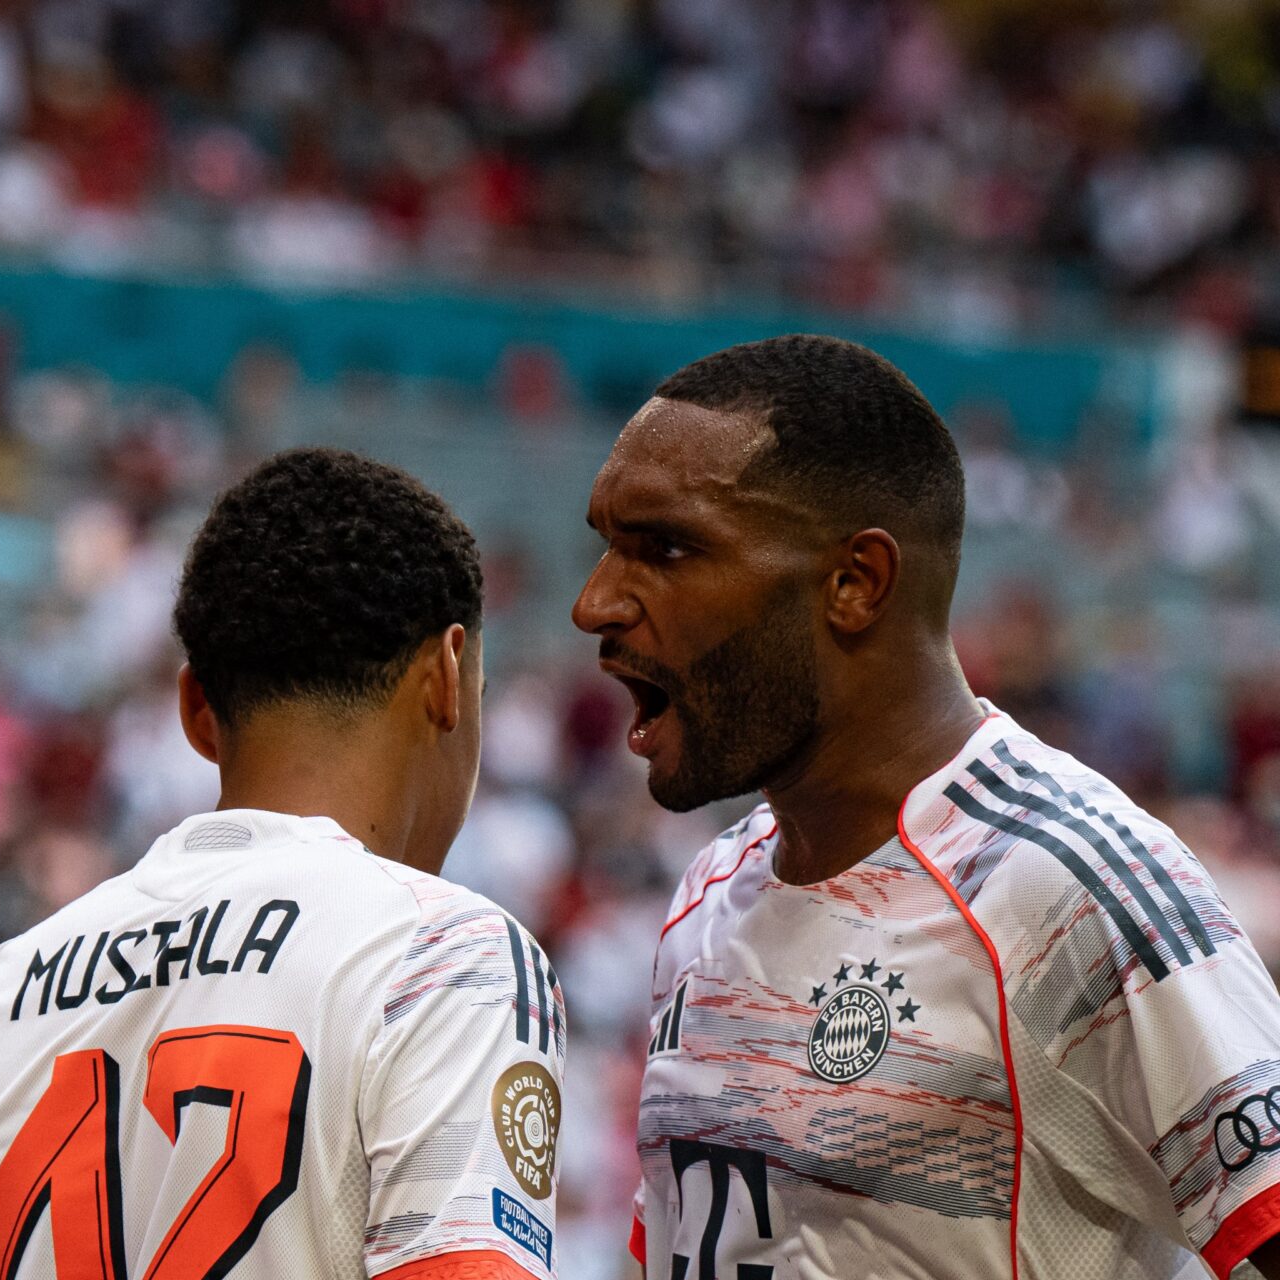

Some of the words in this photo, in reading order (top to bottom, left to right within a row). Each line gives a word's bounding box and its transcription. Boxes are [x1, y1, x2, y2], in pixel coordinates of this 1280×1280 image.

[821, 1002, 839, 1023] FC
[841, 991, 884, 1033] BAYERN
[504, 1075, 543, 1101] WORLD
[543, 1087, 556, 1119] CUP
[501, 1103, 515, 1148] CLUB
[515, 1155, 542, 1191] FIFA
[500, 1195, 531, 1229] FOOTBALL
